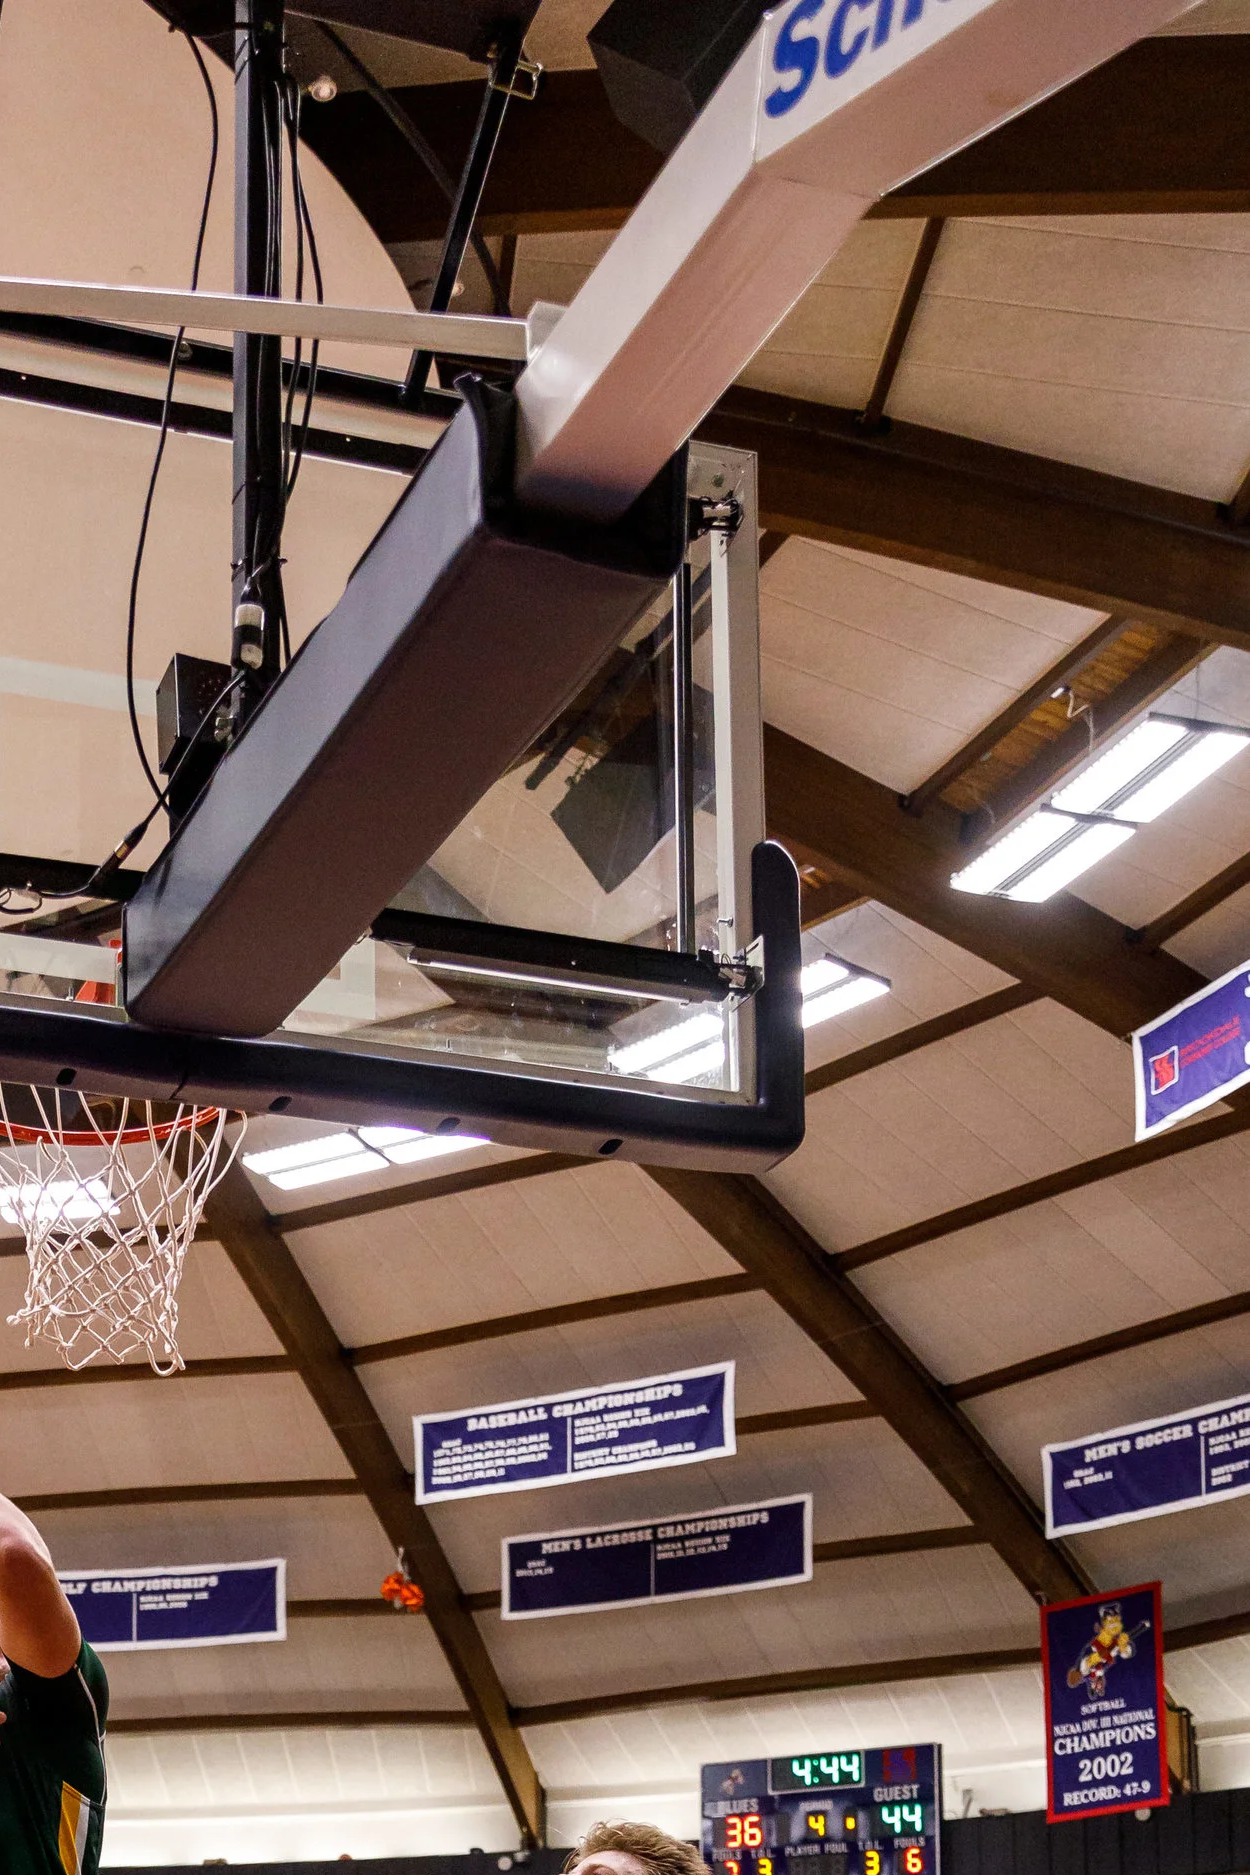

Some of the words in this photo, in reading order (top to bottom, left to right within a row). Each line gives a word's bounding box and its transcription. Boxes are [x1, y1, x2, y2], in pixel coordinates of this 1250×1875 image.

[466, 1406, 548, 1432] BASEBALL
[551, 1383, 683, 1418] CHAMPIONSHIPS
[1084, 1439, 1131, 1463] MEN'S
[1135, 1423, 1194, 1450] SOCCER
[541, 1538, 582, 1555] MEN'S
[585, 1528, 653, 1550] LACROSSE
[656, 1510, 770, 1540] CHAMPIONSHIPS
[90, 1575, 219, 1594] CHAMPIONSHIPS
[1081, 1698, 1126, 1715] SOFTBALL
[1054, 1722, 1156, 1755] CHAMPIONS
[792, 1754, 859, 1786] 4:44
[1079, 1752, 1133, 1782] 2002
[873, 1784, 920, 1802] GUEST
[1063, 1785, 1120, 1806] RECORD:
[725, 1813, 763, 1850] 36
[808, 1814, 825, 1837] 4
[881, 1803, 922, 1834] 44
[904, 1845, 924, 1875] 6
